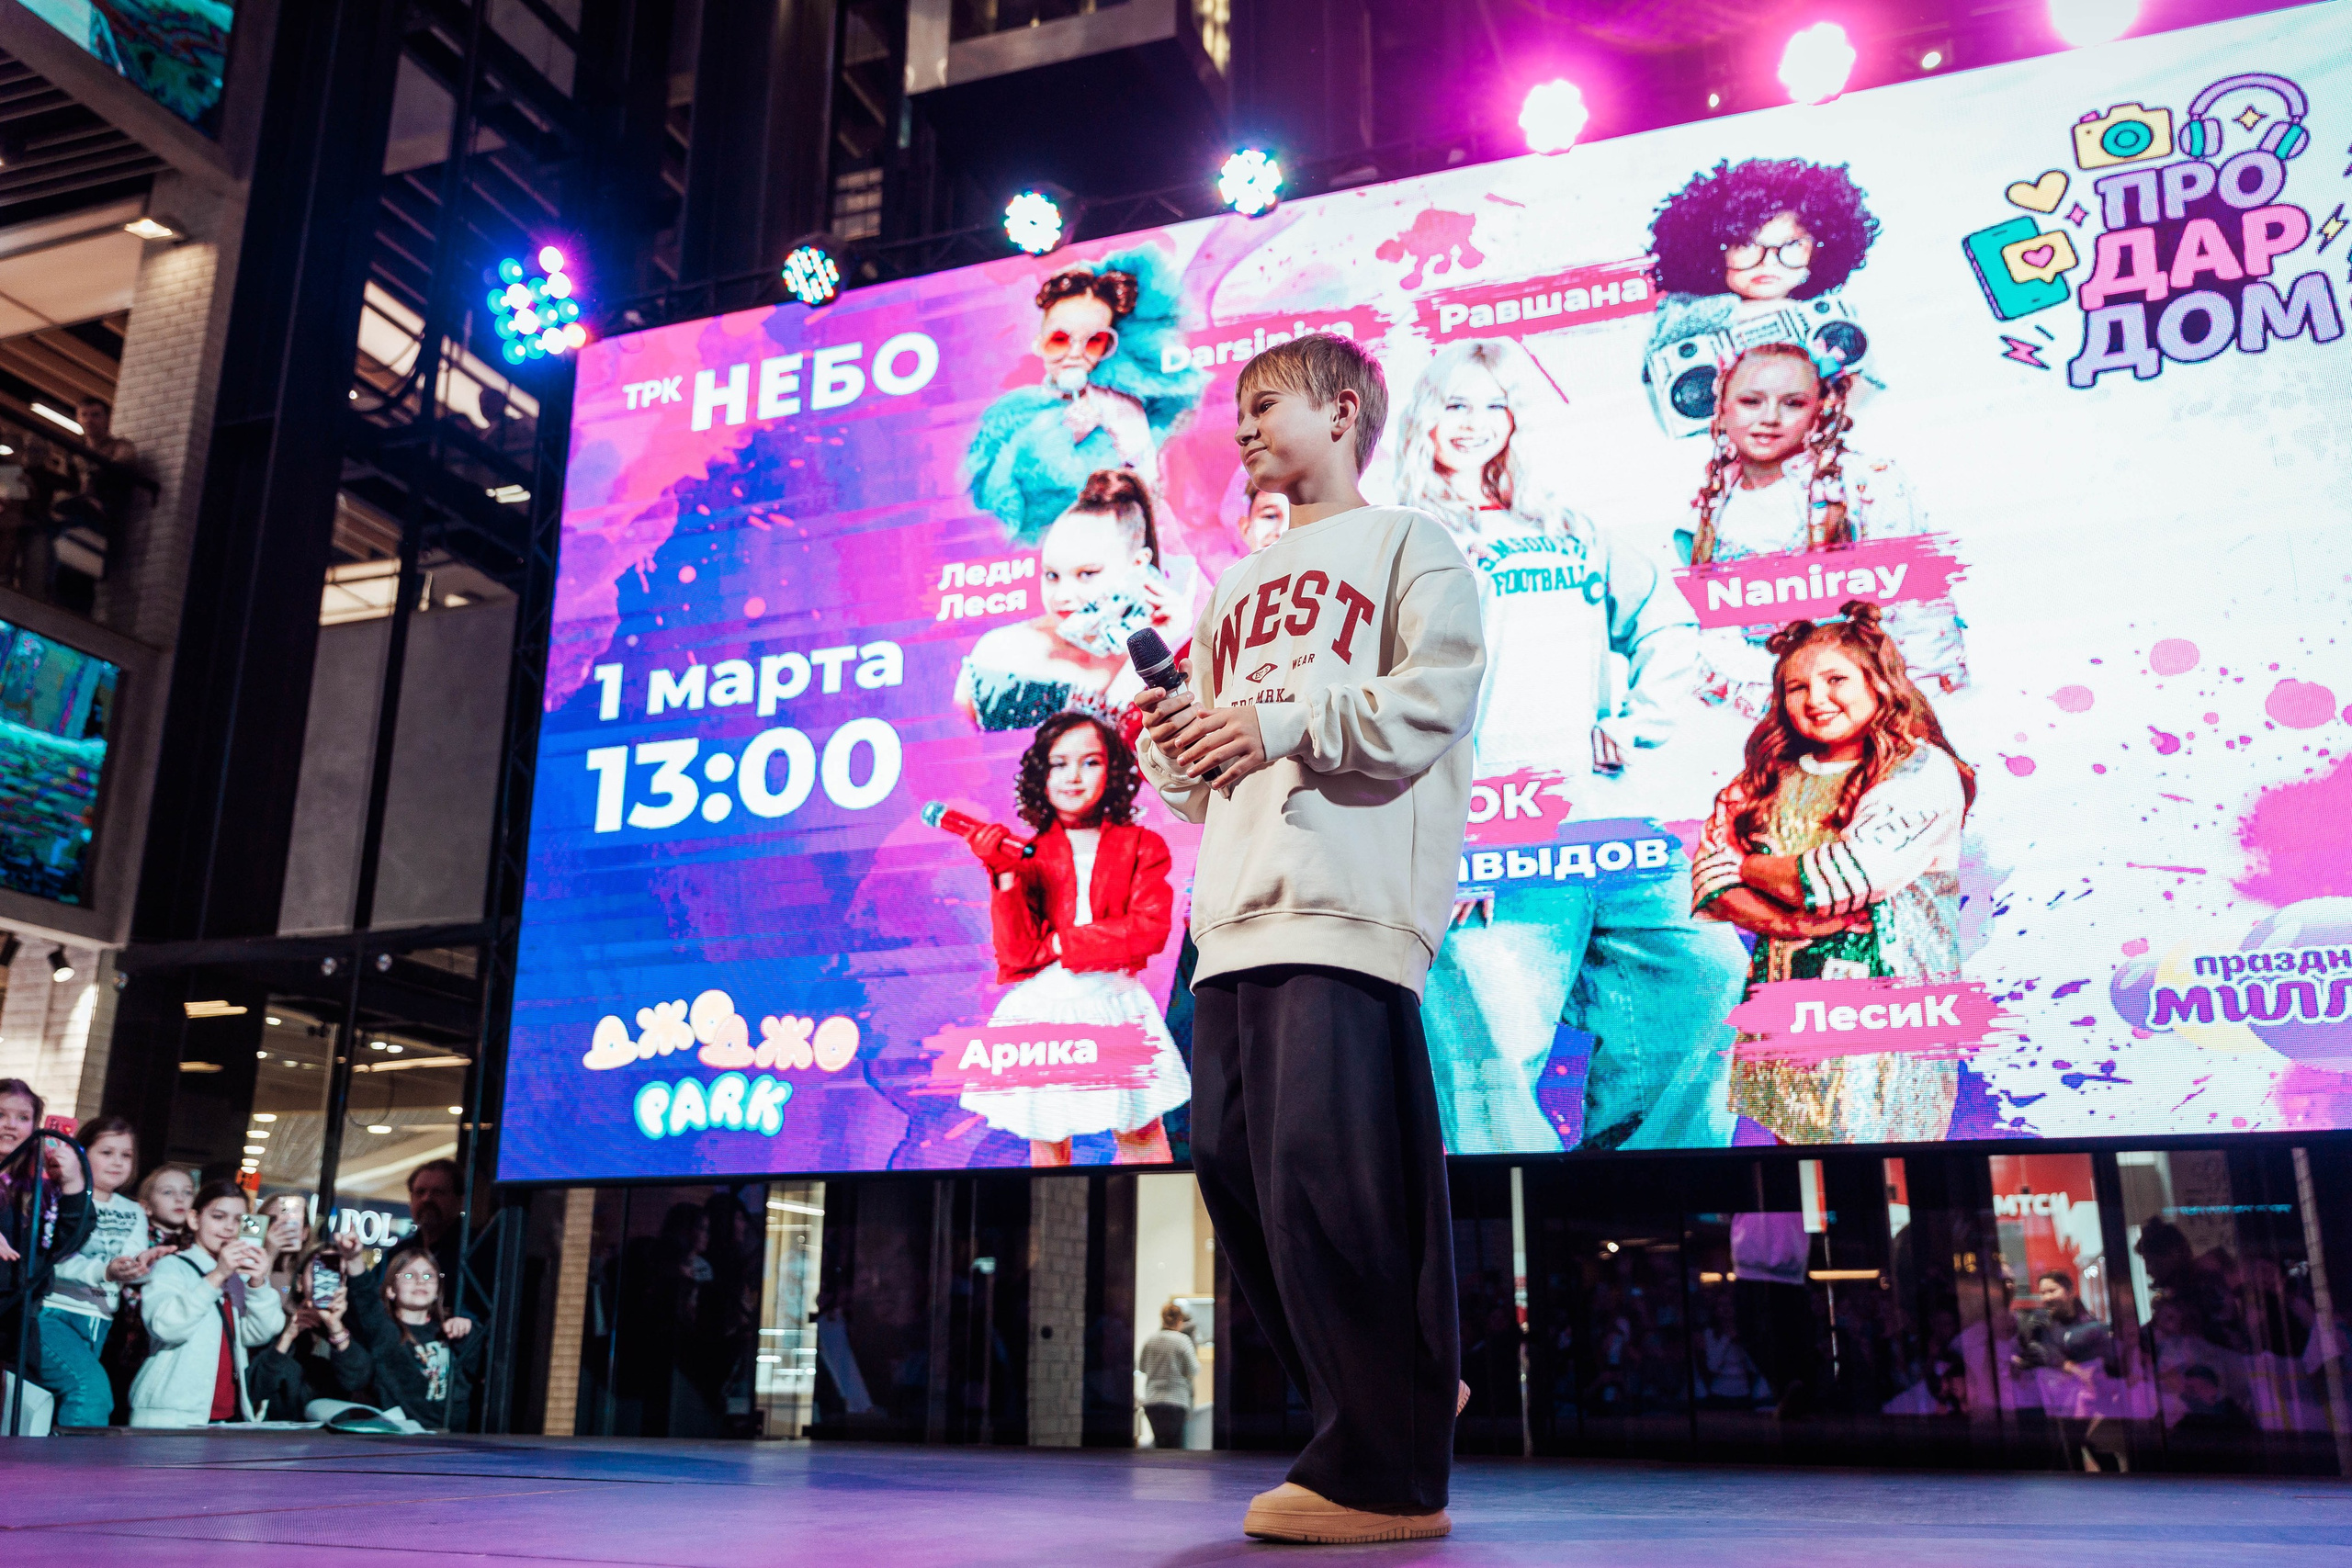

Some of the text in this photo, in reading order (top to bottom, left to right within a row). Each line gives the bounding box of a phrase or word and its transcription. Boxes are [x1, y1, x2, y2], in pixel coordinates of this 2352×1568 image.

[2094, 149, 2288, 230] ПРО
[2077, 203, 2312, 310] ДАР
[1439, 276, 1648, 334] Равшана
[2068, 271, 2345, 389] ДОМ
[623, 332, 940, 432] ТРК НЕБО
[935, 589, 1027, 622] Леся
[937, 558, 1035, 592] Леди
[1706, 559, 1909, 613] Naniray
[1213, 570, 1376, 700] WEST
[1292, 653, 1316, 671] WEAR
[594, 640, 904, 721] 1 марта
[585, 716, 903, 833] 13:00
[582, 989, 860, 1072] ДЖОДЖО
[1789, 994, 1963, 1034] ЛесиК
[959, 1037, 1099, 1072] Арика
[634, 1071, 793, 1140] PARK
